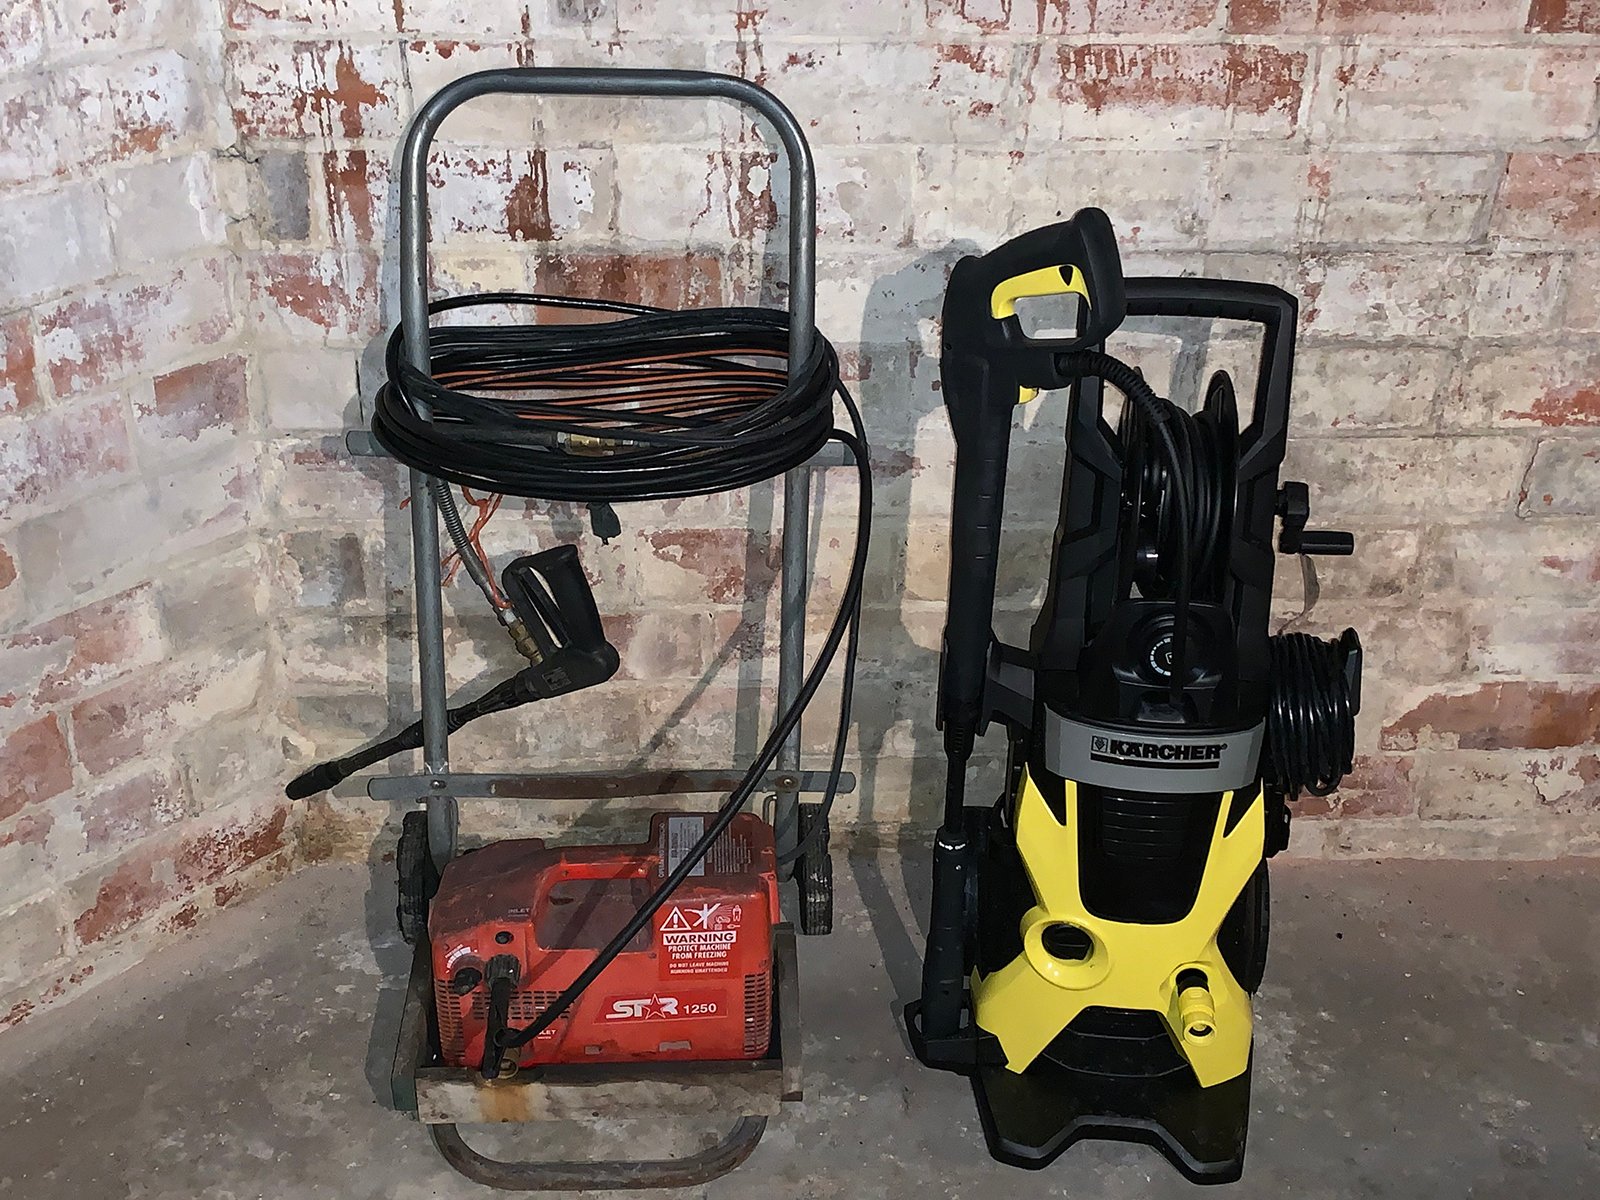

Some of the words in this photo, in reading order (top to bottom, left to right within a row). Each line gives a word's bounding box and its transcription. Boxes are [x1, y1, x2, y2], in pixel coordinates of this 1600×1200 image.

[665, 932, 734, 944] WARNING
[700, 943, 731, 951] MACHINE
[672, 952, 693, 960] FROM
[694, 951, 727, 959] FREEZING
[606, 993, 678, 1019] STAR
[683, 1003, 717, 1014] 1250
